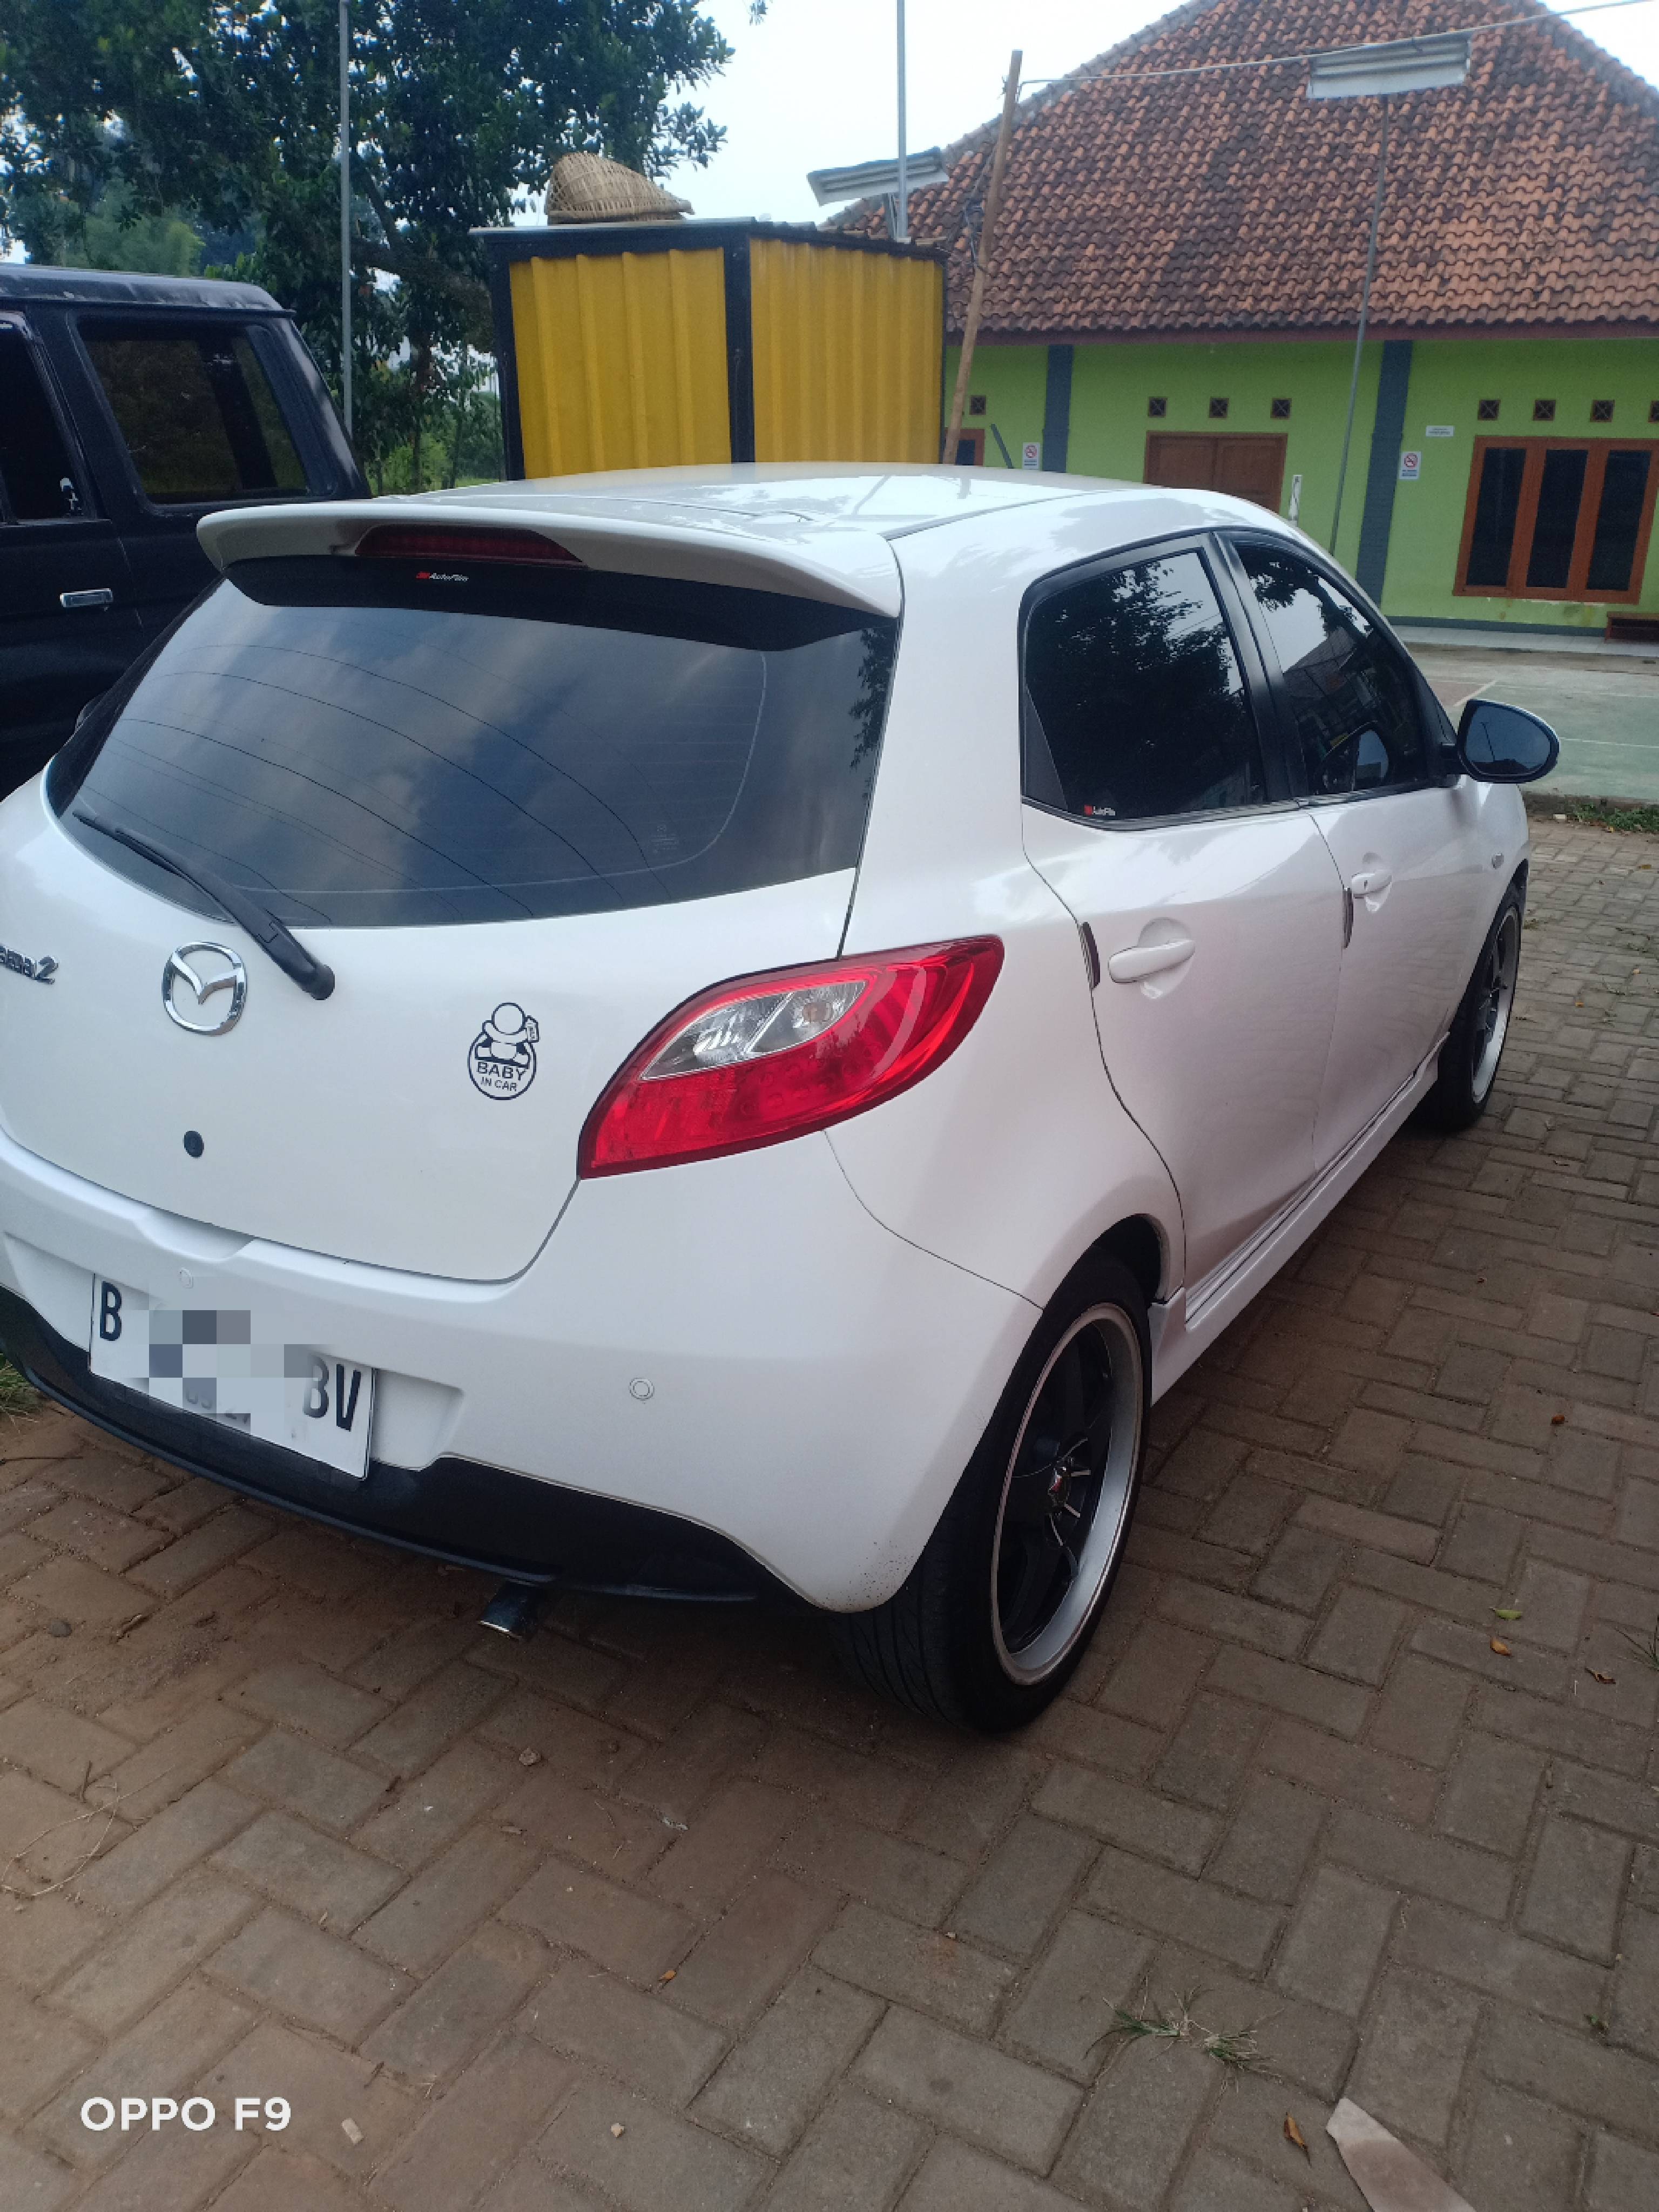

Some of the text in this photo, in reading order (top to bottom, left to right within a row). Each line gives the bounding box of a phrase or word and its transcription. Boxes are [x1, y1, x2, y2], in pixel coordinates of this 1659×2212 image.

[477, 1061, 527, 1081] BABY
[481, 1077, 517, 1091] IN CAR
[99, 1280, 122, 1341] B
